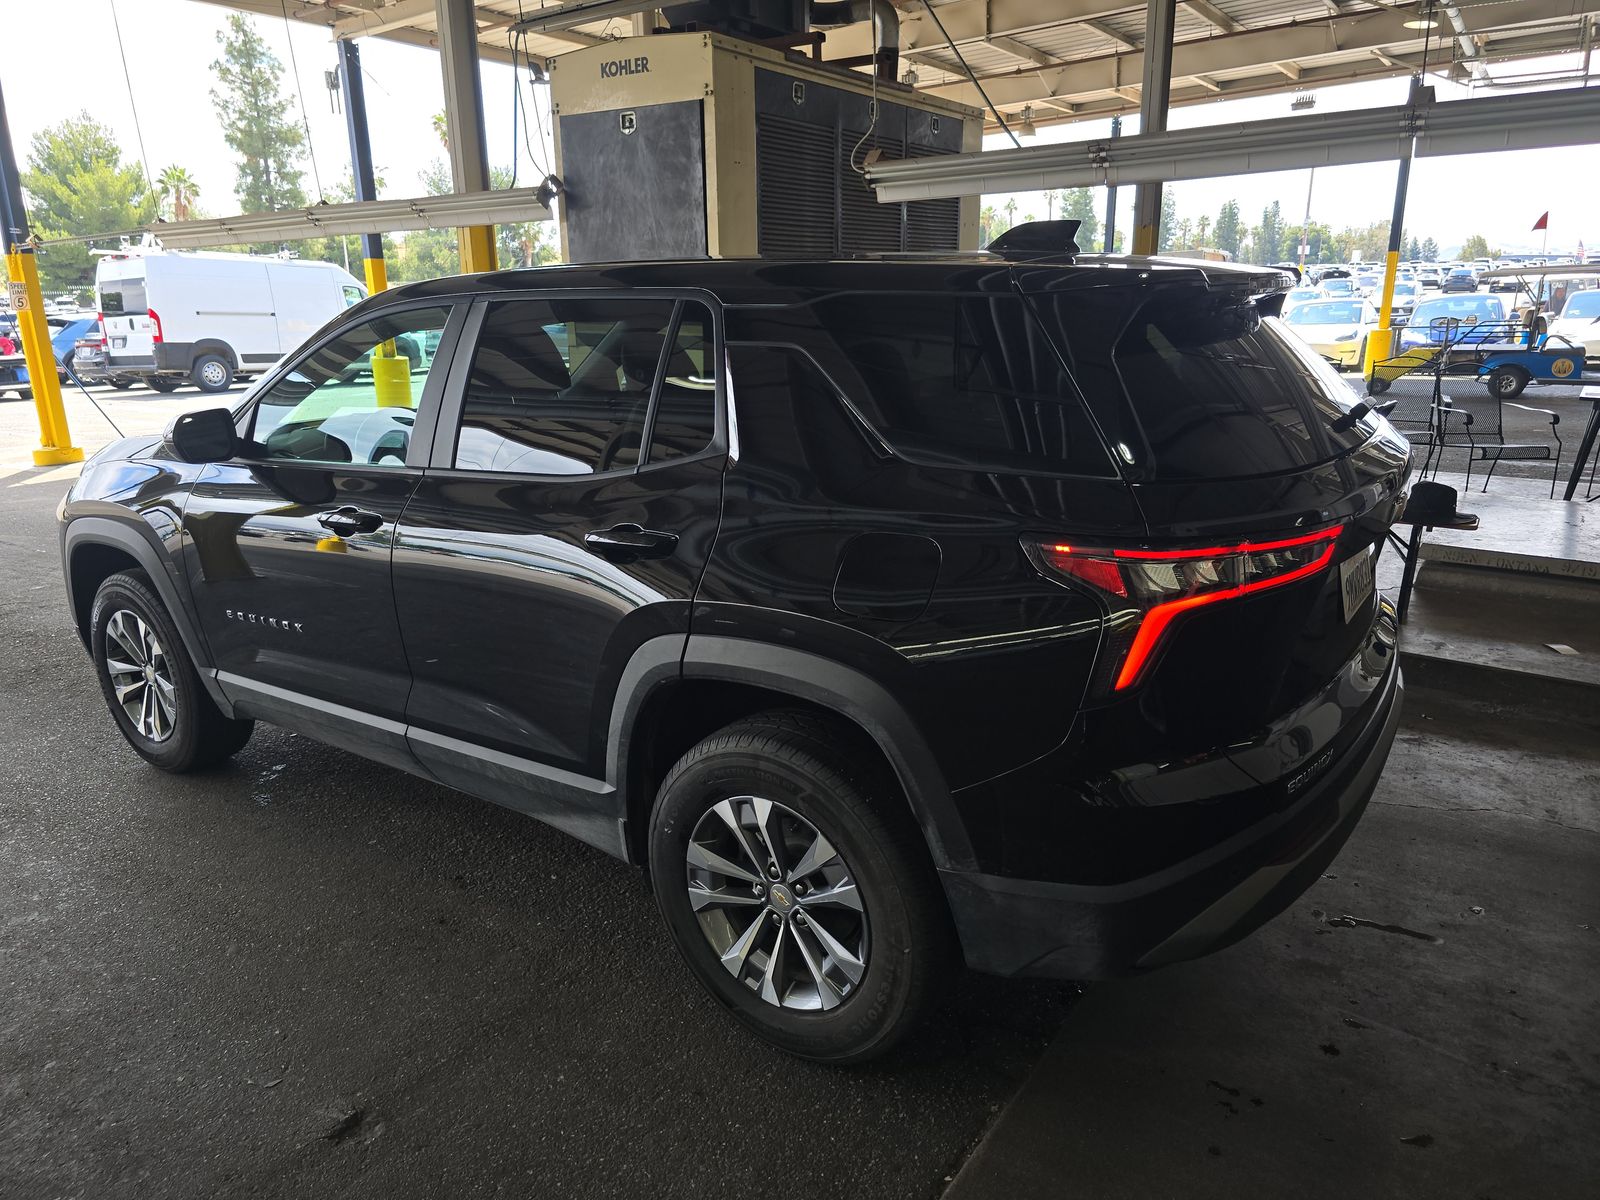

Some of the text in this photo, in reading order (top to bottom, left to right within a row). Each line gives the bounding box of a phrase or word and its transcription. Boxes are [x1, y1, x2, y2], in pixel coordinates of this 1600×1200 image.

[600, 56, 650, 79] KOHLER
[17, 297, 24, 308] 5
[226, 609, 303, 633] EQUINOX
